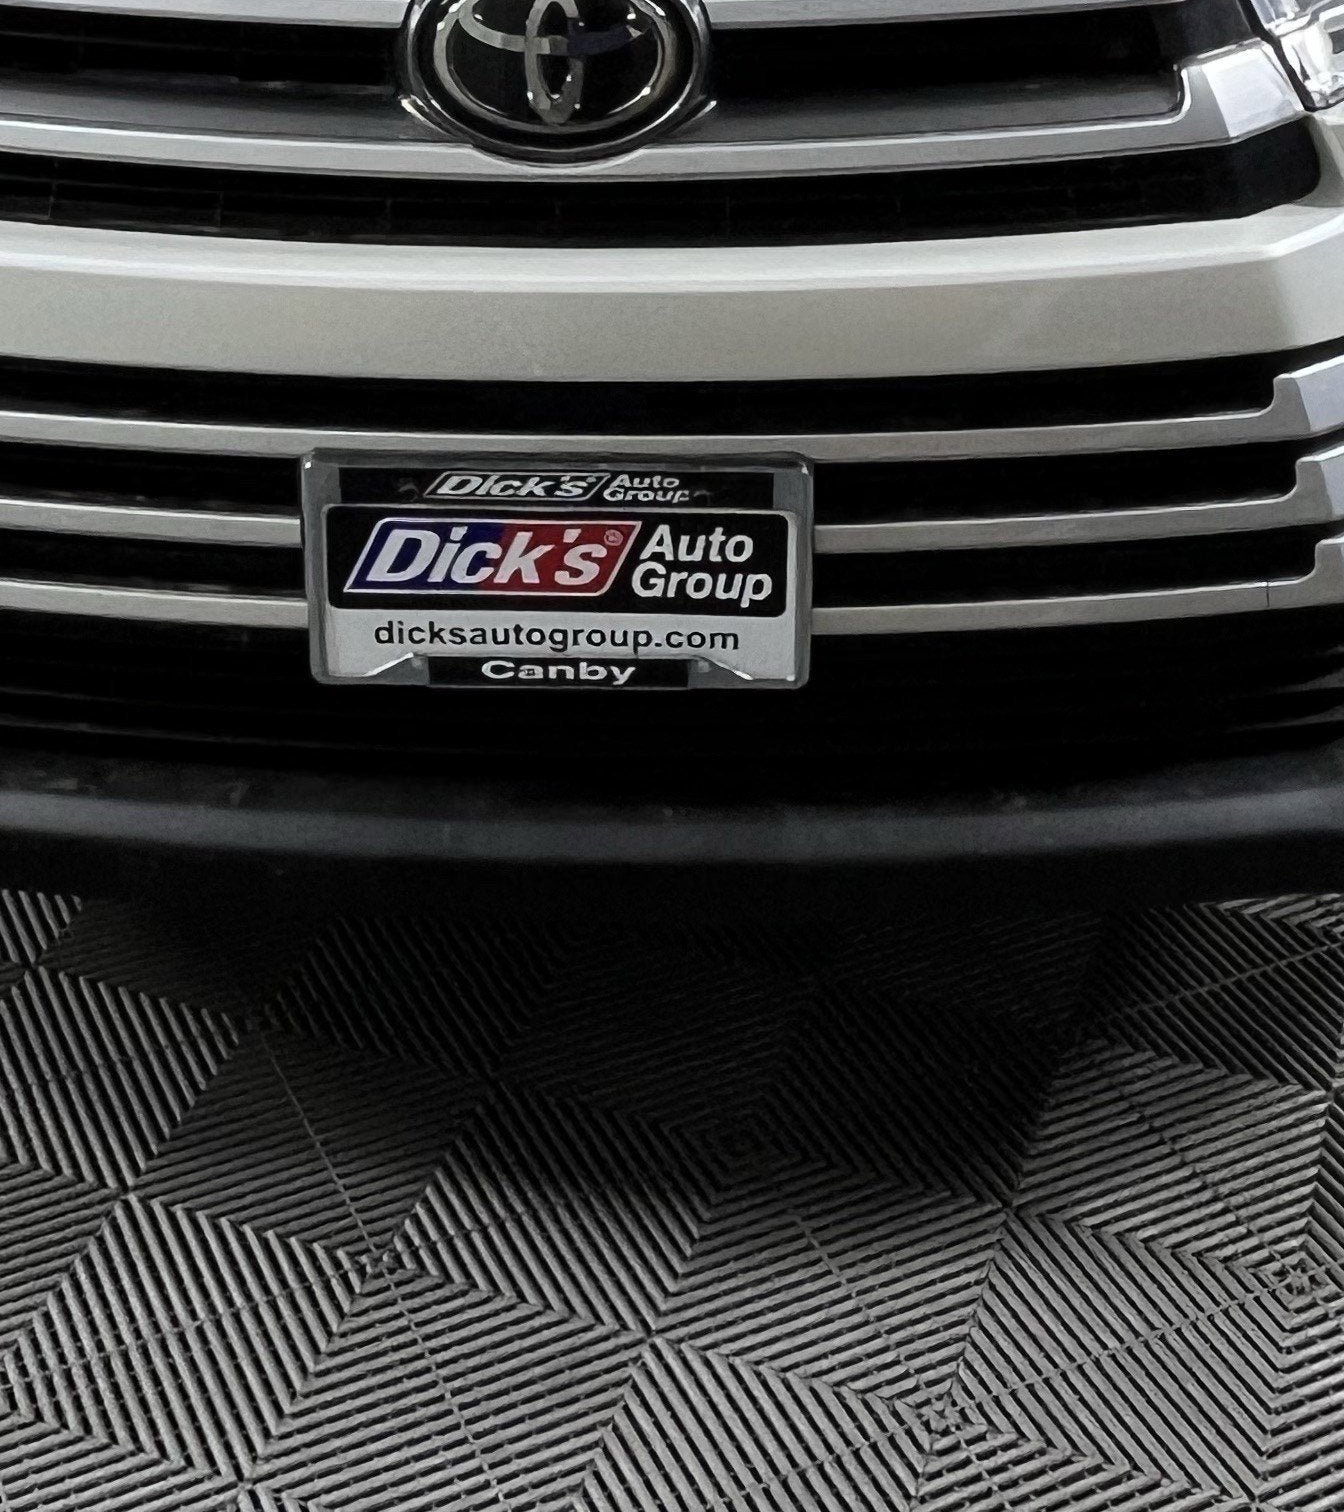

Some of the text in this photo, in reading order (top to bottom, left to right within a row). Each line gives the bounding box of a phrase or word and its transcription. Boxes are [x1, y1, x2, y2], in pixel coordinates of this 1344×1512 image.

[436, 474, 589, 497] Dick's
[603, 488, 690, 503] Group
[610, 474, 680, 489] Auto
[366, 526, 608, 585] Dick's
[640, 525, 753, 564] Auto
[631, 562, 773, 608] Group
[374, 621, 739, 654] dicksautogroup.com
[481, 660, 636, 685] Canby
